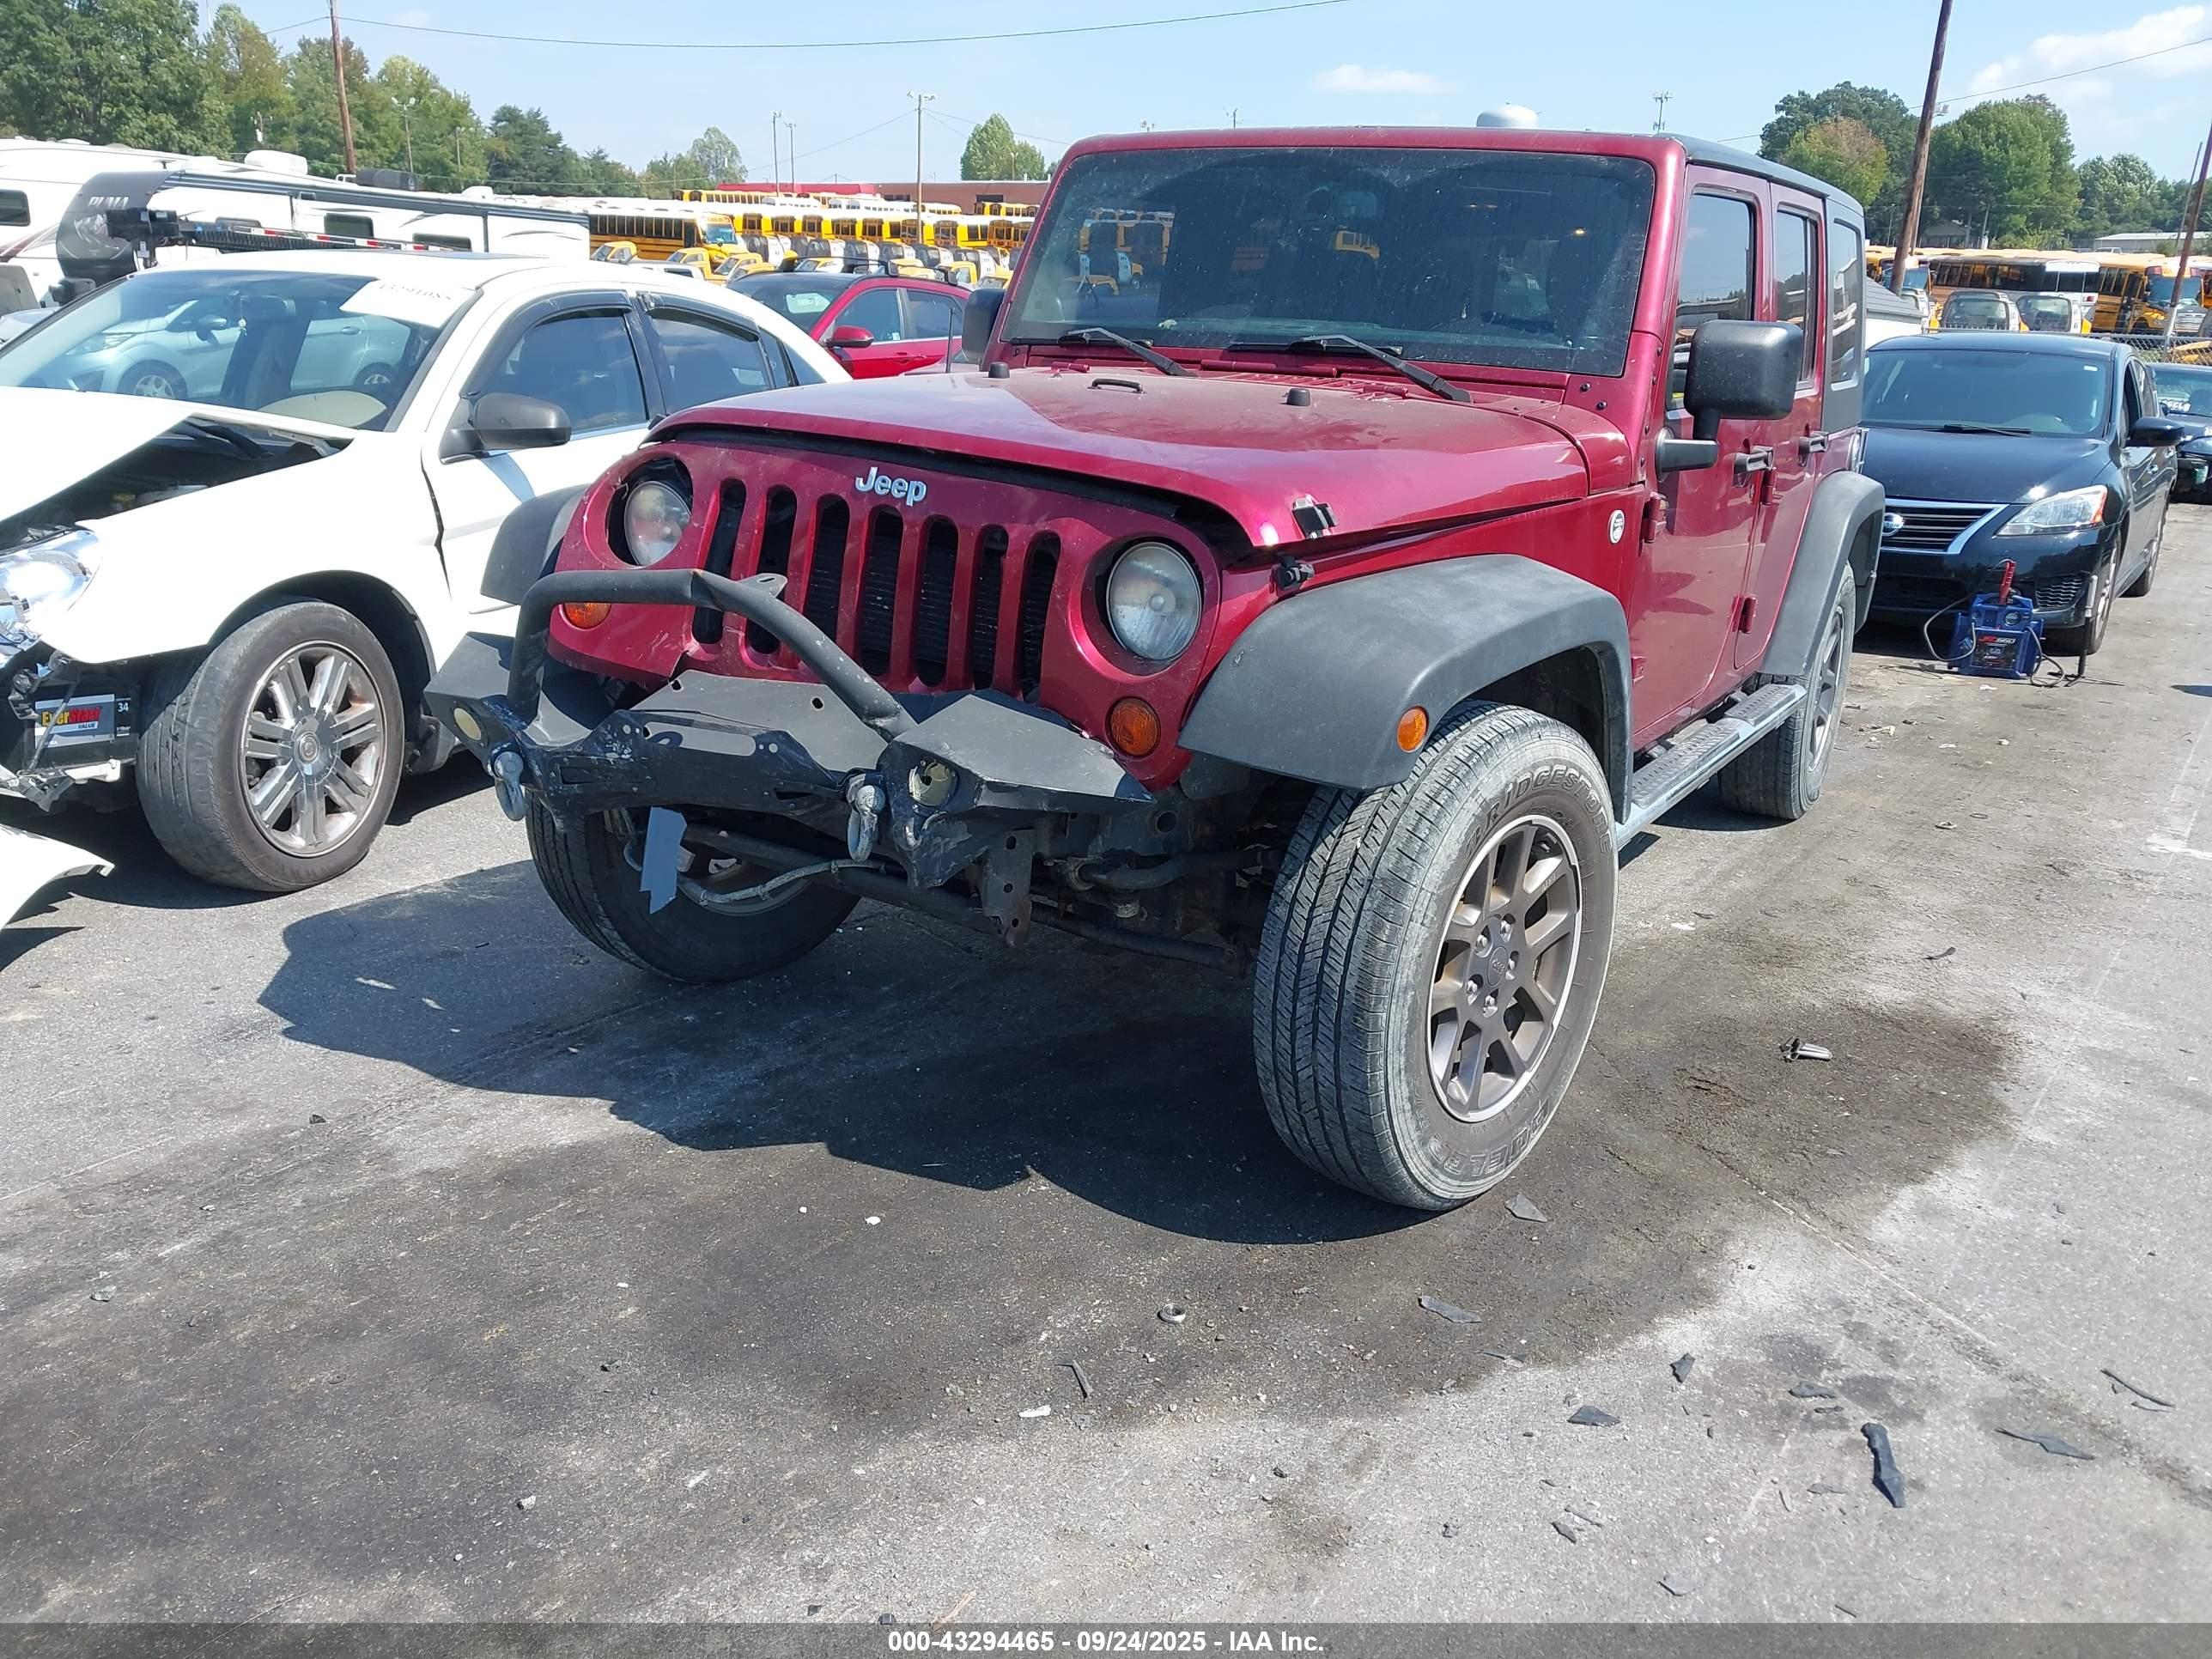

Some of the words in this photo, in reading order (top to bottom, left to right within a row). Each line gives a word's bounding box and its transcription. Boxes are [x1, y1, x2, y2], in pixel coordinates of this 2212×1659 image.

[88, 196, 130, 210] PUMA
[854, 466, 927, 507] Jeep
[118, 702, 129, 713] 34
[77, 721, 96, 730] VALUE
[1465, 763, 1613, 854] BRIDGESTONE
